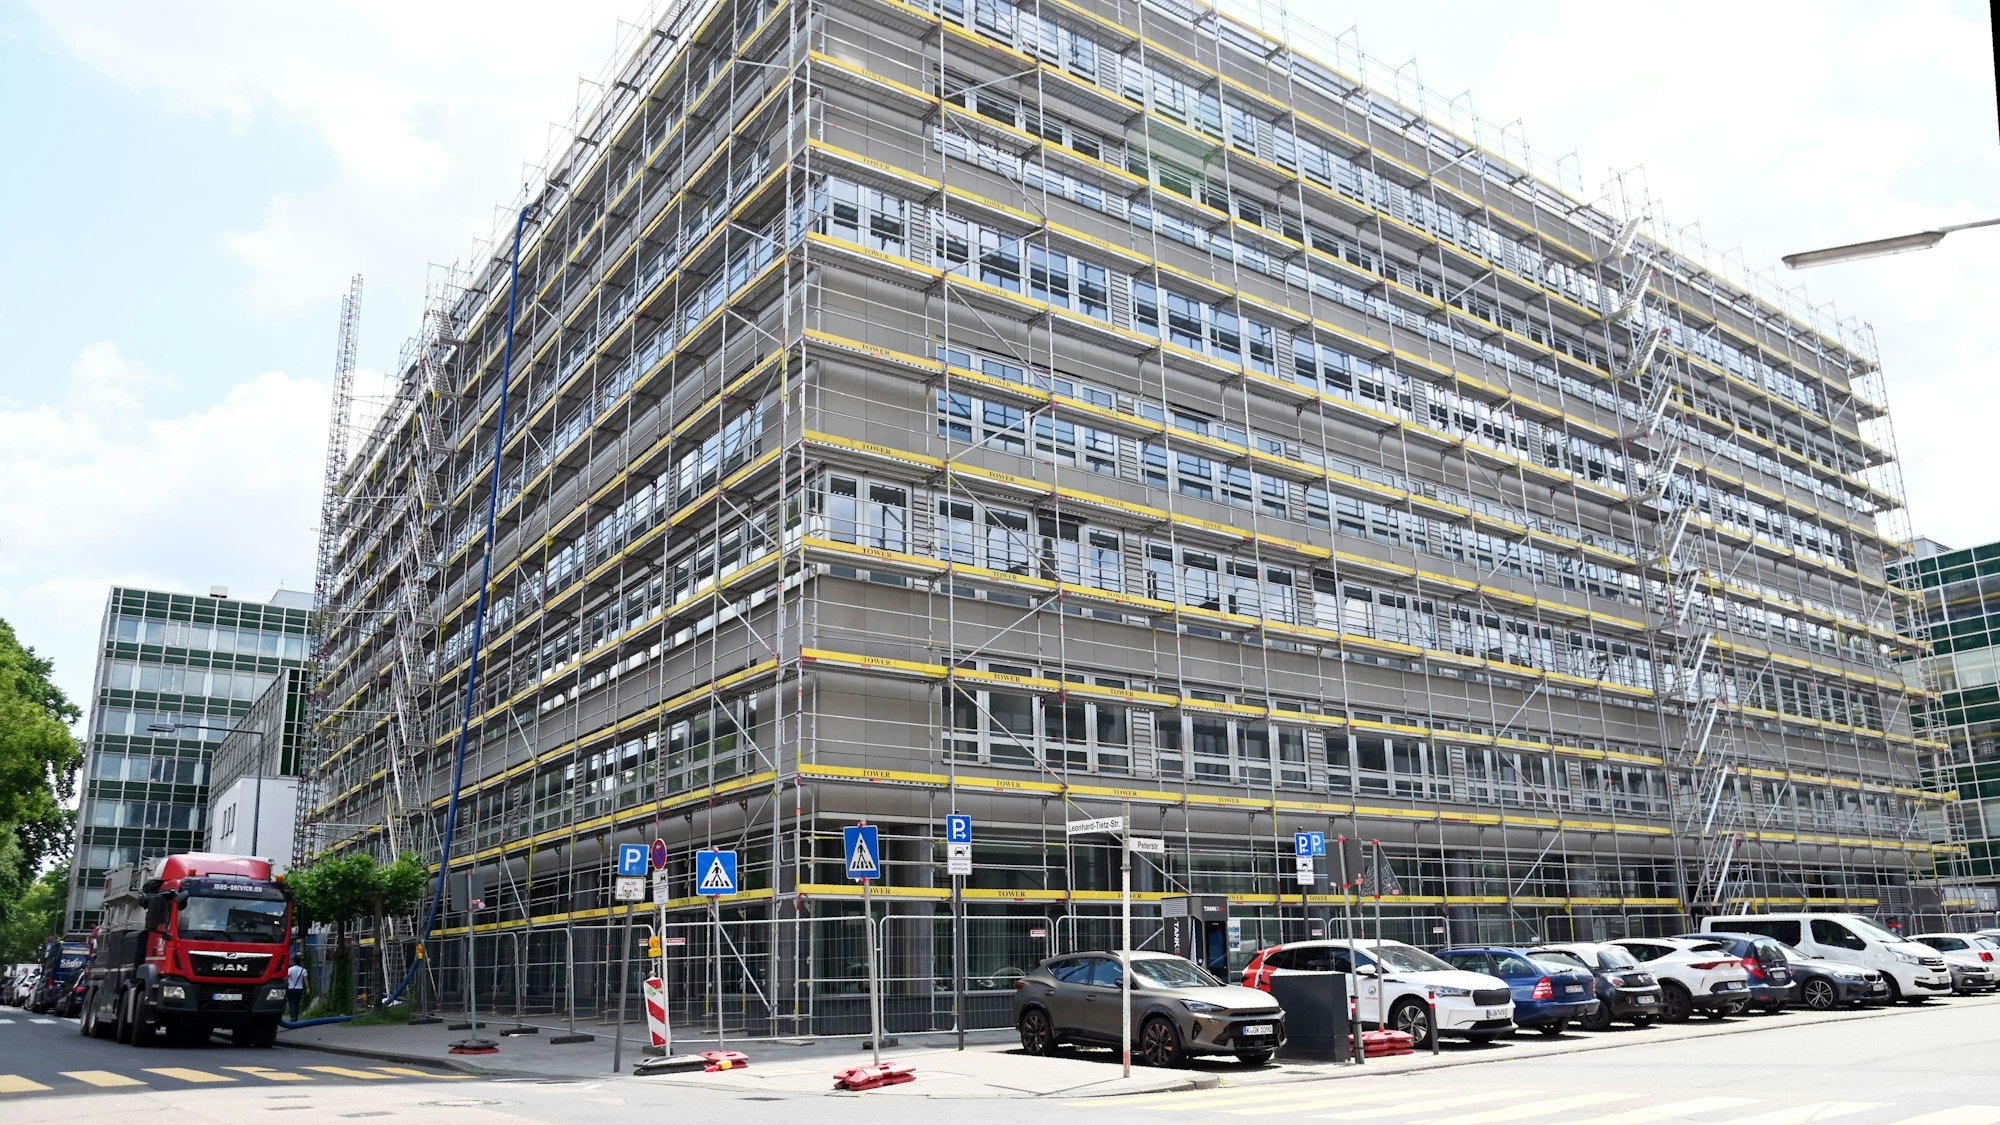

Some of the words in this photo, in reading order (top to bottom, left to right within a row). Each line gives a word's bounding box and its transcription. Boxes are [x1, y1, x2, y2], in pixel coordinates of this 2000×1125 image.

[861, 69, 888, 83] TOWER
[863, 157, 890, 170] TOWER
[864, 248, 890, 260] TOWER
[862, 344, 890, 356] TOWER
[988, 378, 1012, 388] TOWER
[862, 443, 892, 454] TOWER
[989, 472, 1015, 482] TOWER
[863, 548, 892, 558] TOWER
[993, 572, 1018, 580] TOWER
[1106, 592, 1130, 600] TOWER
[863, 658, 891, 666] TOWER
[994, 674, 1021, 682] TOWER
[1110, 689, 1134, 698] TOWER
[862, 770, 890, 778] TOWER
[953, 818, 966, 839] P
[1068, 820, 1120, 832] Leonhard-Tietz-Str.
[1138, 841, 1160, 850] Peterstr.
[1299, 836, 1308, 853] P
[1312, 835, 1321, 852] P
[625, 849, 641, 872] P
[214, 883, 262, 893] mas-service.eu
[212, 964, 248, 972] MAN
